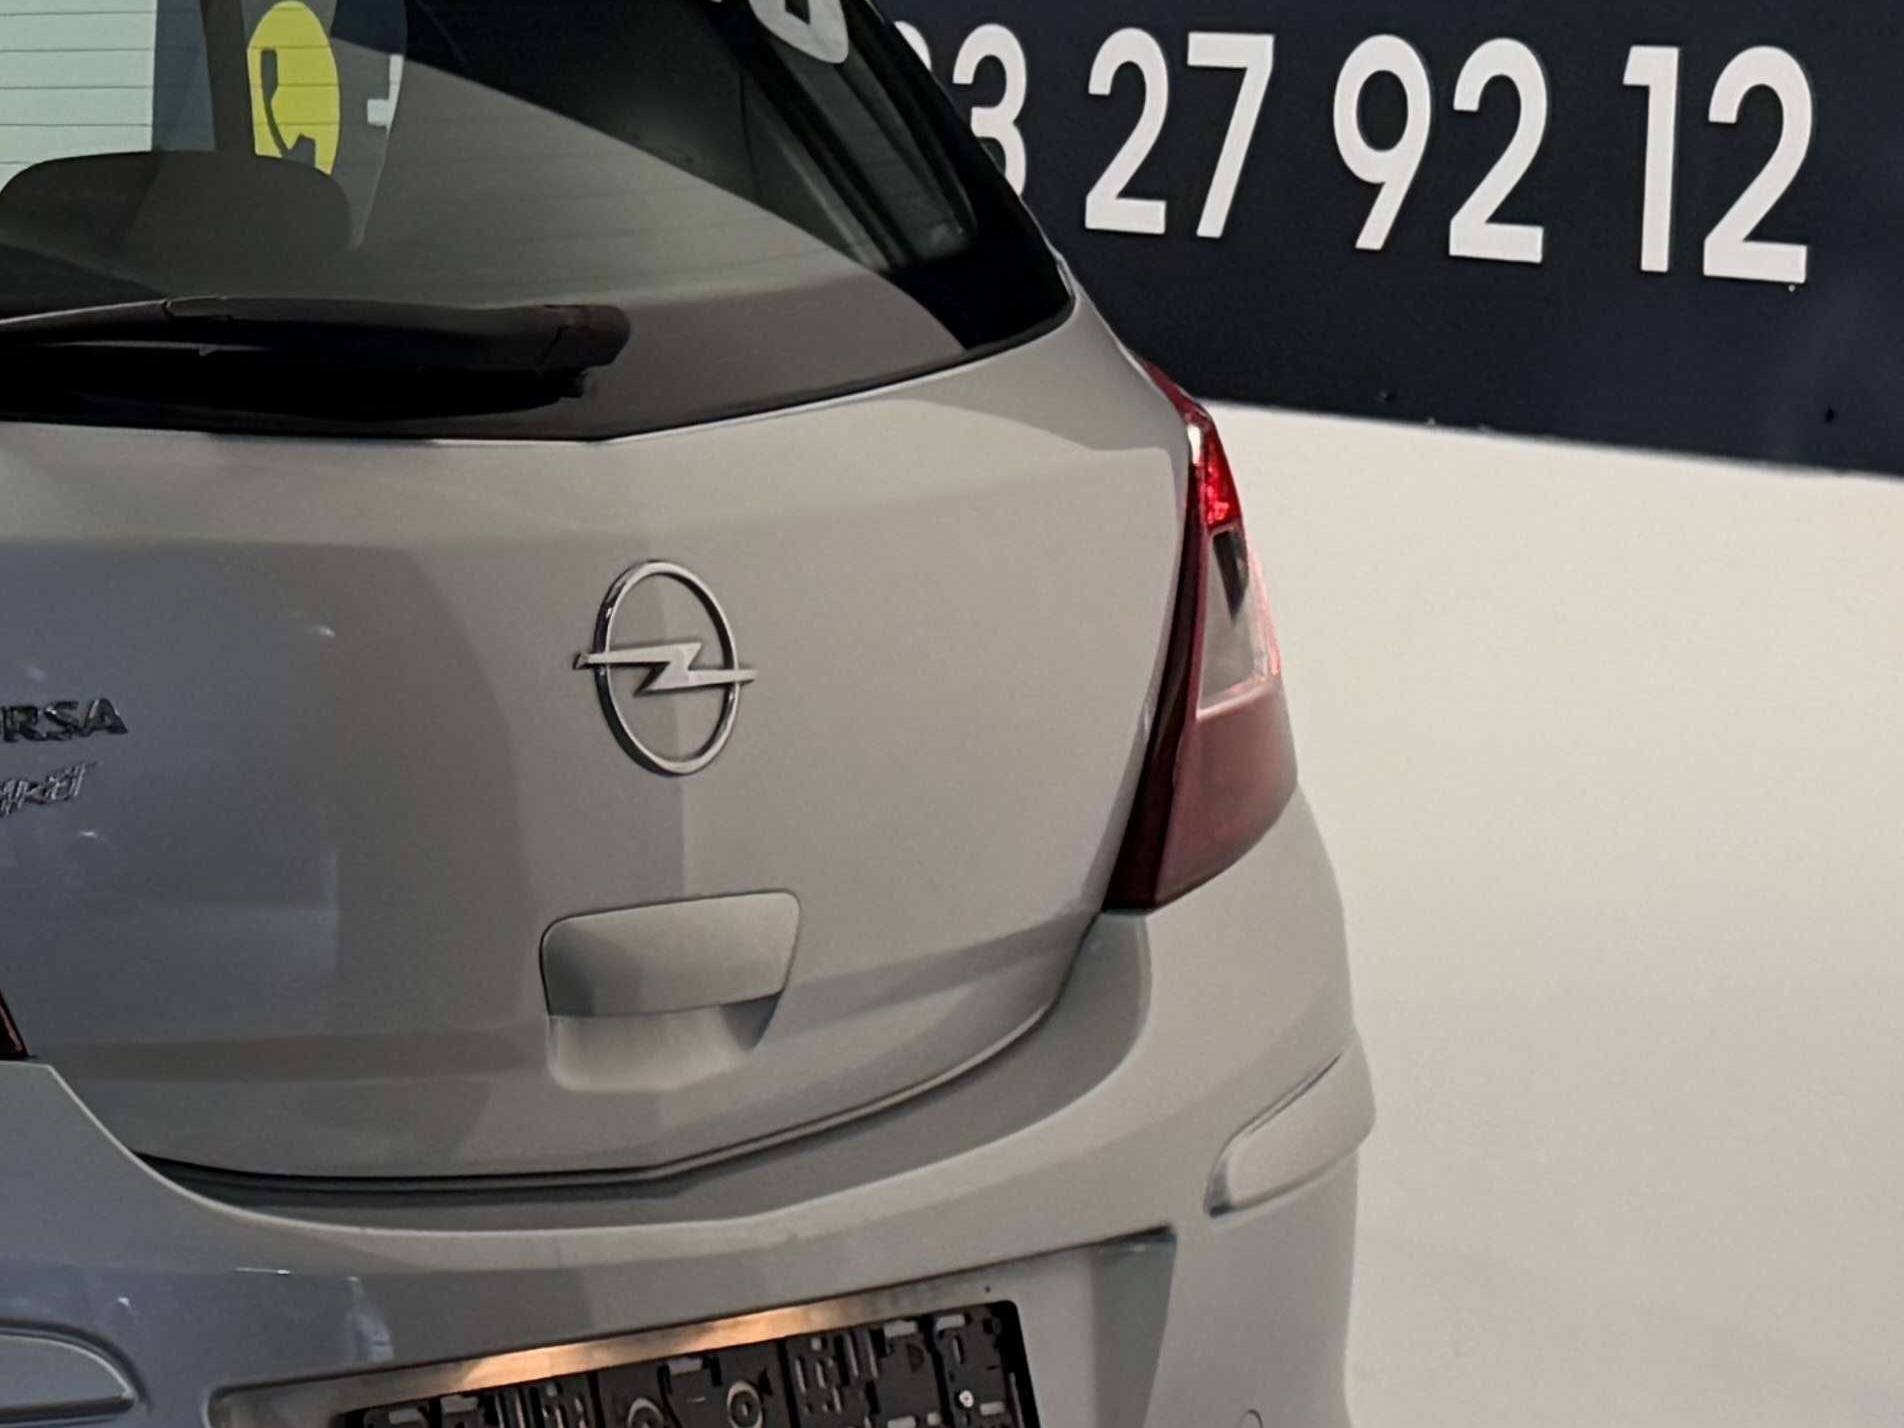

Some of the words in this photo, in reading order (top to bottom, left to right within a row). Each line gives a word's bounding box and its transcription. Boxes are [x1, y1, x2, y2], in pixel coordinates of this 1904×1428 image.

[892, 19, 1028, 199] 3
[1084, 26, 1275, 240] 27
[1332, 33, 1550, 265] 92
[1622, 44, 1813, 284] 12
